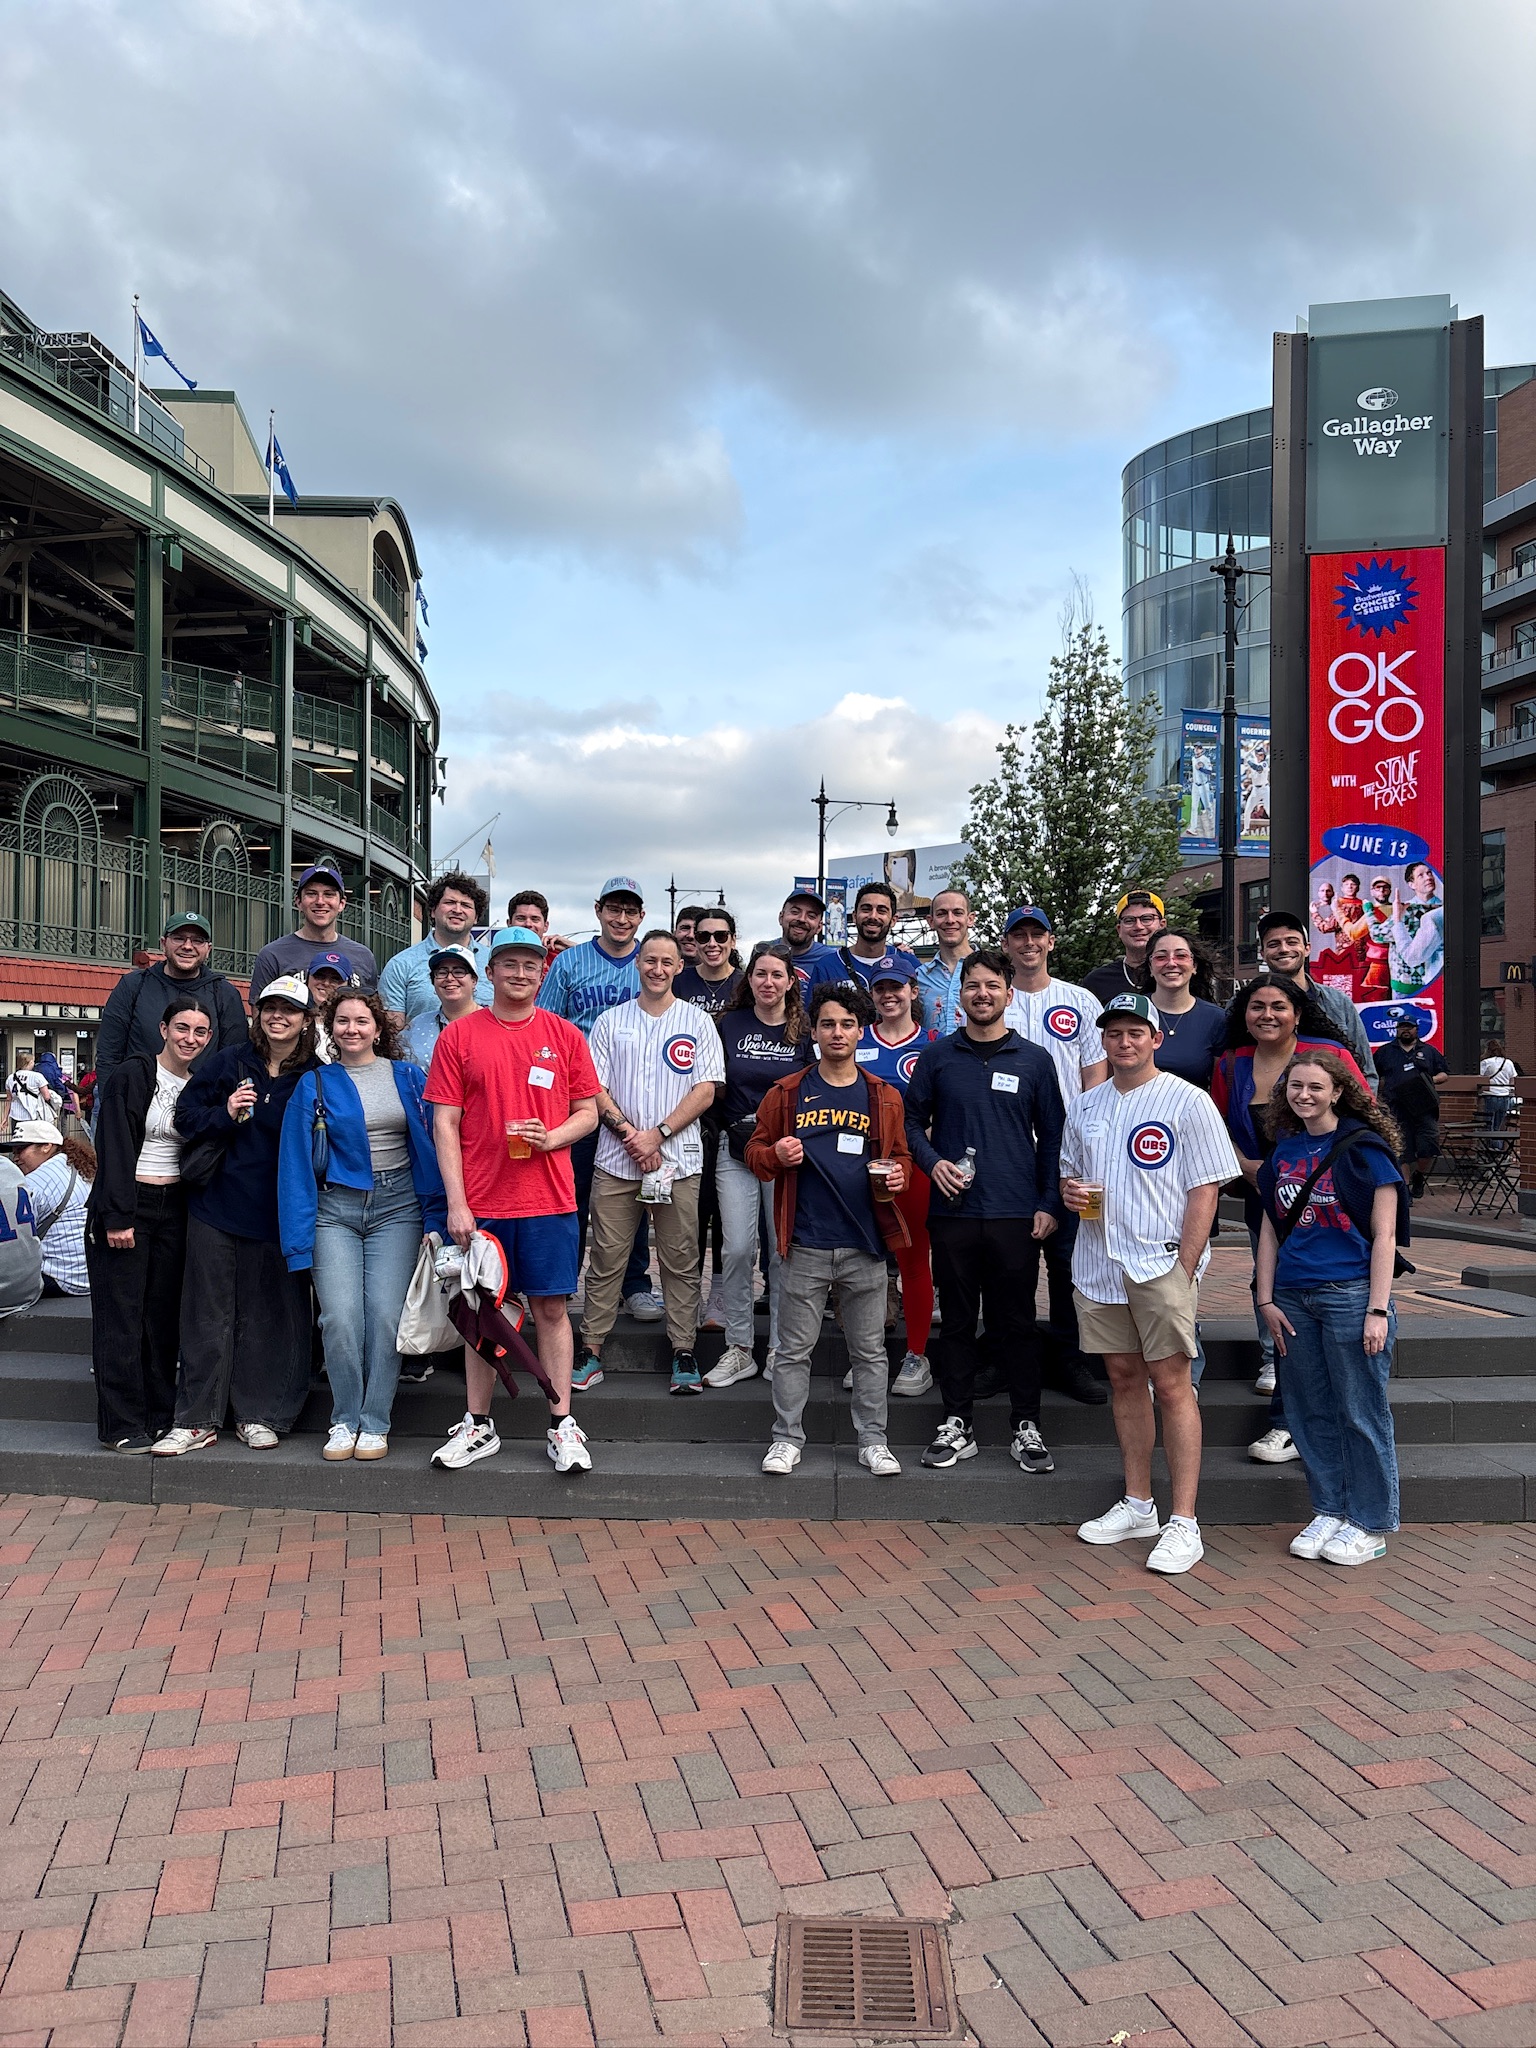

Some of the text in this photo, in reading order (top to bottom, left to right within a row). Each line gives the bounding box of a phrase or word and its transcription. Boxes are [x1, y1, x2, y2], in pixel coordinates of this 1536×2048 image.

[32, 332, 84, 346] WINE
[1322, 413, 1434, 437] Gallagher
[1353, 437, 1402, 457] Way
[1352, 594, 1402, 612] CONCERT
[1355, 589, 1397, 603] Budweiser
[1362, 602, 1395, 615] SERIES
[1328, 651, 1417, 698] OK
[1185, 723, 1217, 733] COUNSELL
[1328, 697, 1424, 744] GO
[1331, 775, 1357, 787] WITH
[1375, 750, 1421, 790] STONE
[1360, 782, 1376, 798] THE
[1374, 780, 1418, 811] FOXES
[1340, 833, 1409, 858] JUNE 13
[573, 984, 641, 1013] CHICA
[1050, 1010, 1077, 1035] CUBS
[669, 1040, 696, 1067] CUBS
[796, 1108, 871, 1137] BREWER
[1134, 1128, 1168, 1161] CUBS
